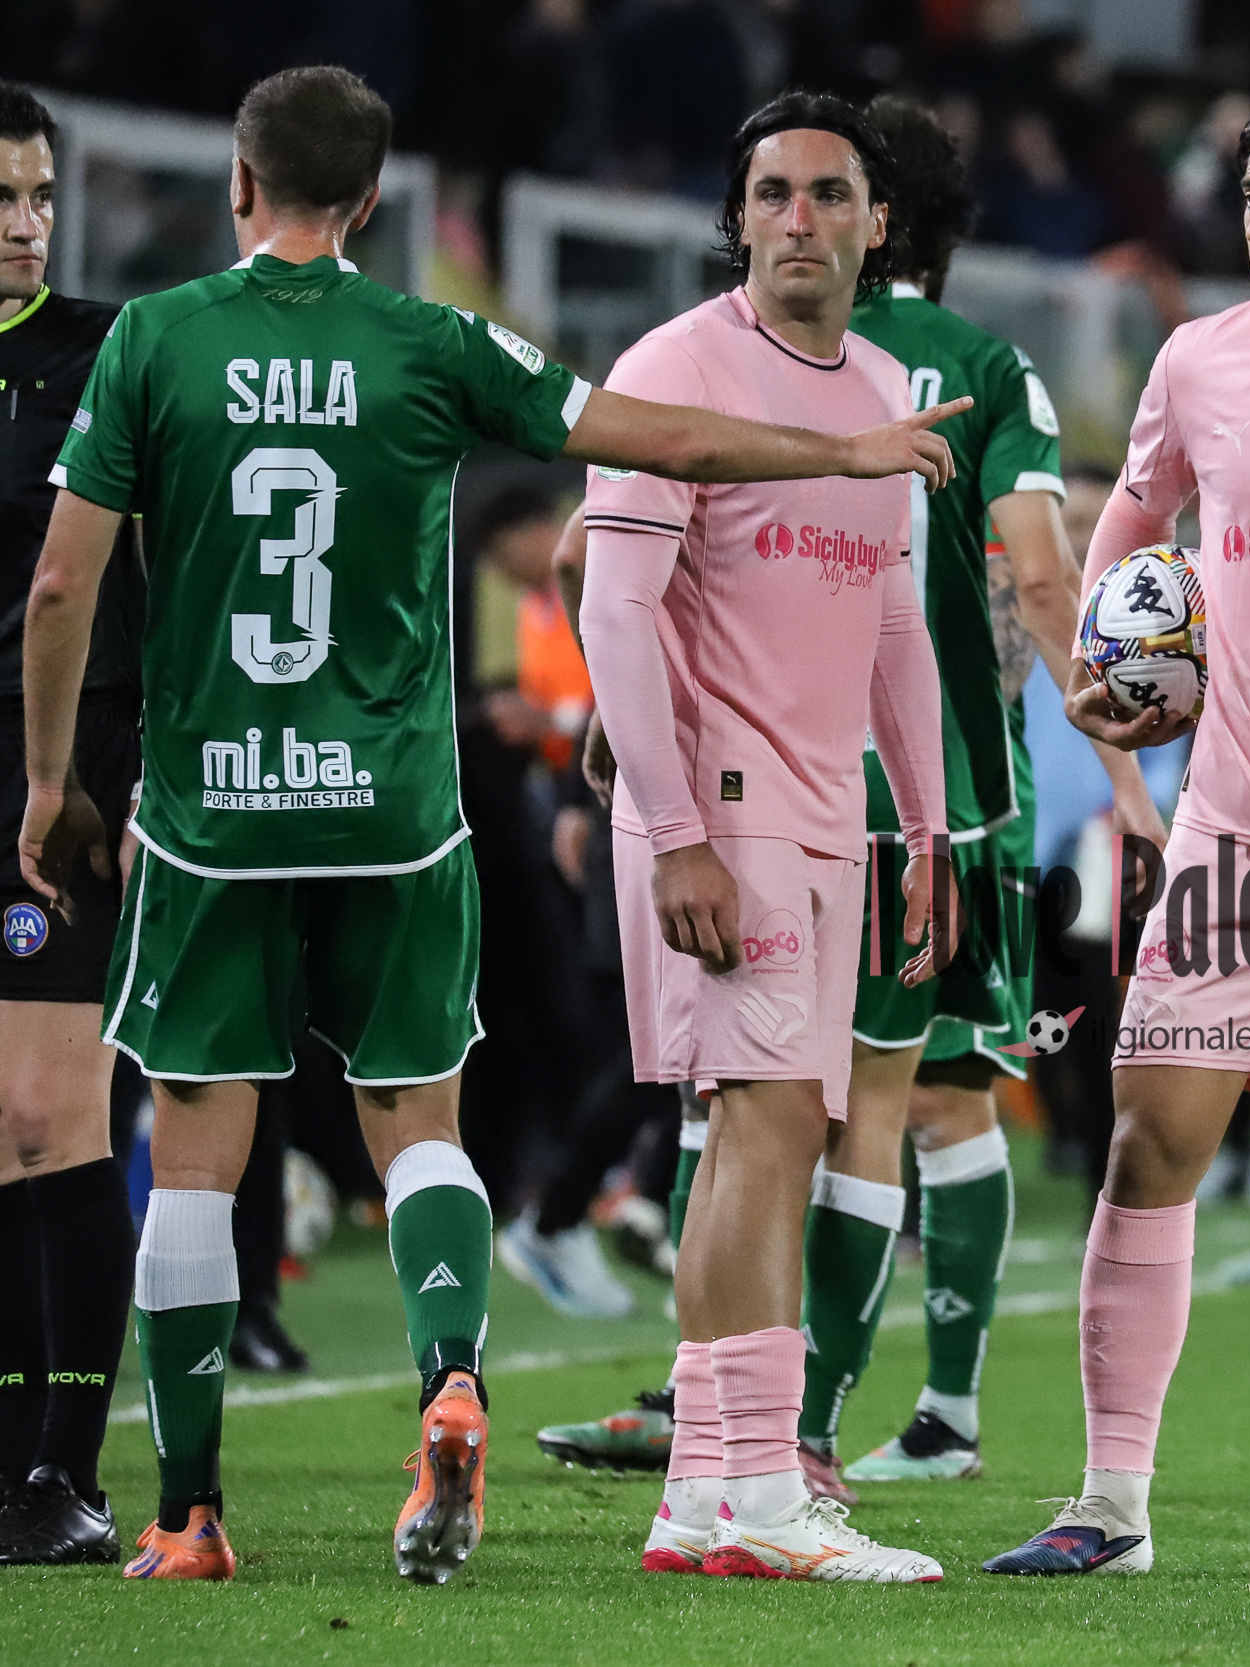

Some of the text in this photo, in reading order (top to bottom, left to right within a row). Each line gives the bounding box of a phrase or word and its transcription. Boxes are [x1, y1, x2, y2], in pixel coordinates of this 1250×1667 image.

[225, 359, 357, 426] SALA
[231, 448, 348, 684] 3
[818, 559, 872, 596] My Love
[202, 727, 373, 790] mi.ba.
[205, 791, 370, 809] PORTE & FINESTRE
[9, 917, 38, 936] AIA
